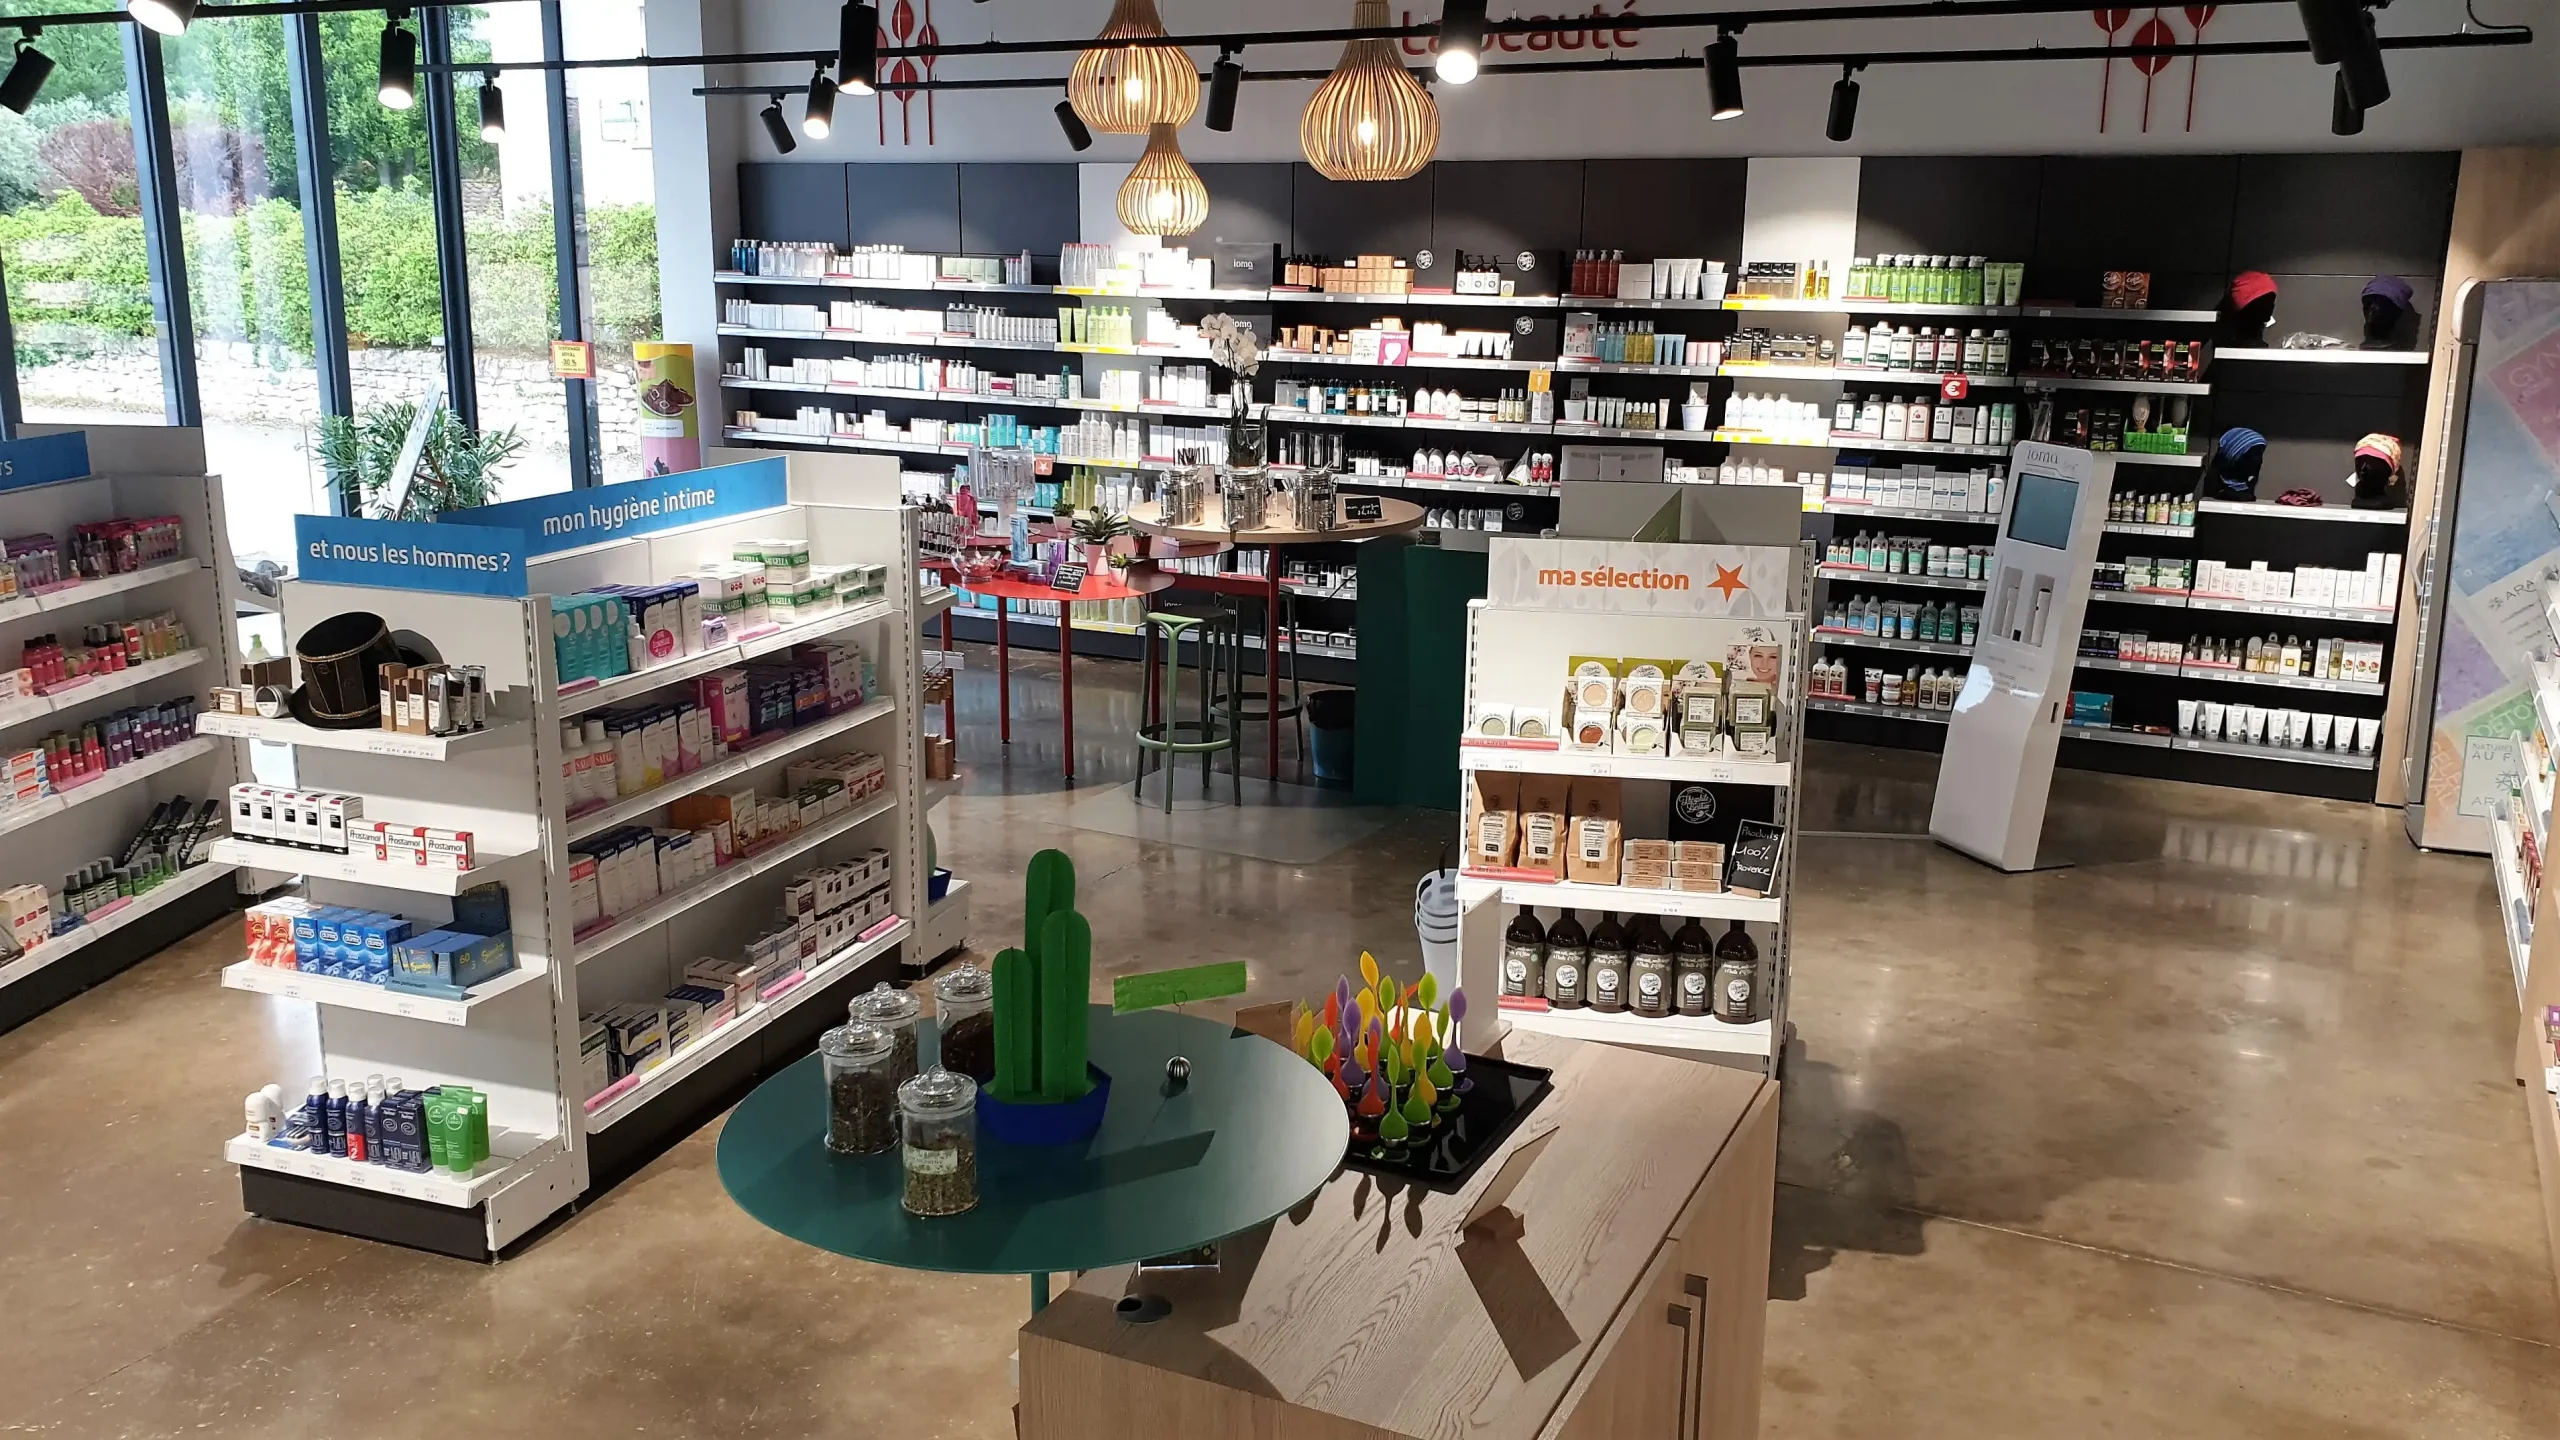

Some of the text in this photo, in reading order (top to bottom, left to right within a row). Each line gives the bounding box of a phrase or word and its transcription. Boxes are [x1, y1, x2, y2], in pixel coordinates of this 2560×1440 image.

[2027, 445, 2058, 464] ioma
[543, 488, 715, 536] mon hygiène intime
[310, 540, 329, 559] et
[333, 544, 378, 562] nous
[382, 543, 409, 565] les
[1539, 565, 1690, 590] ma sélection
[350, 829, 382, 842] Prostamol
[1742, 826, 1779, 840] Produits
[388, 834, 421, 848] Prostamol
[428, 839, 463, 852] Prostamol
[1736, 844, 1771, 860] 100%
[350, 1147, 359, 1160] 2
